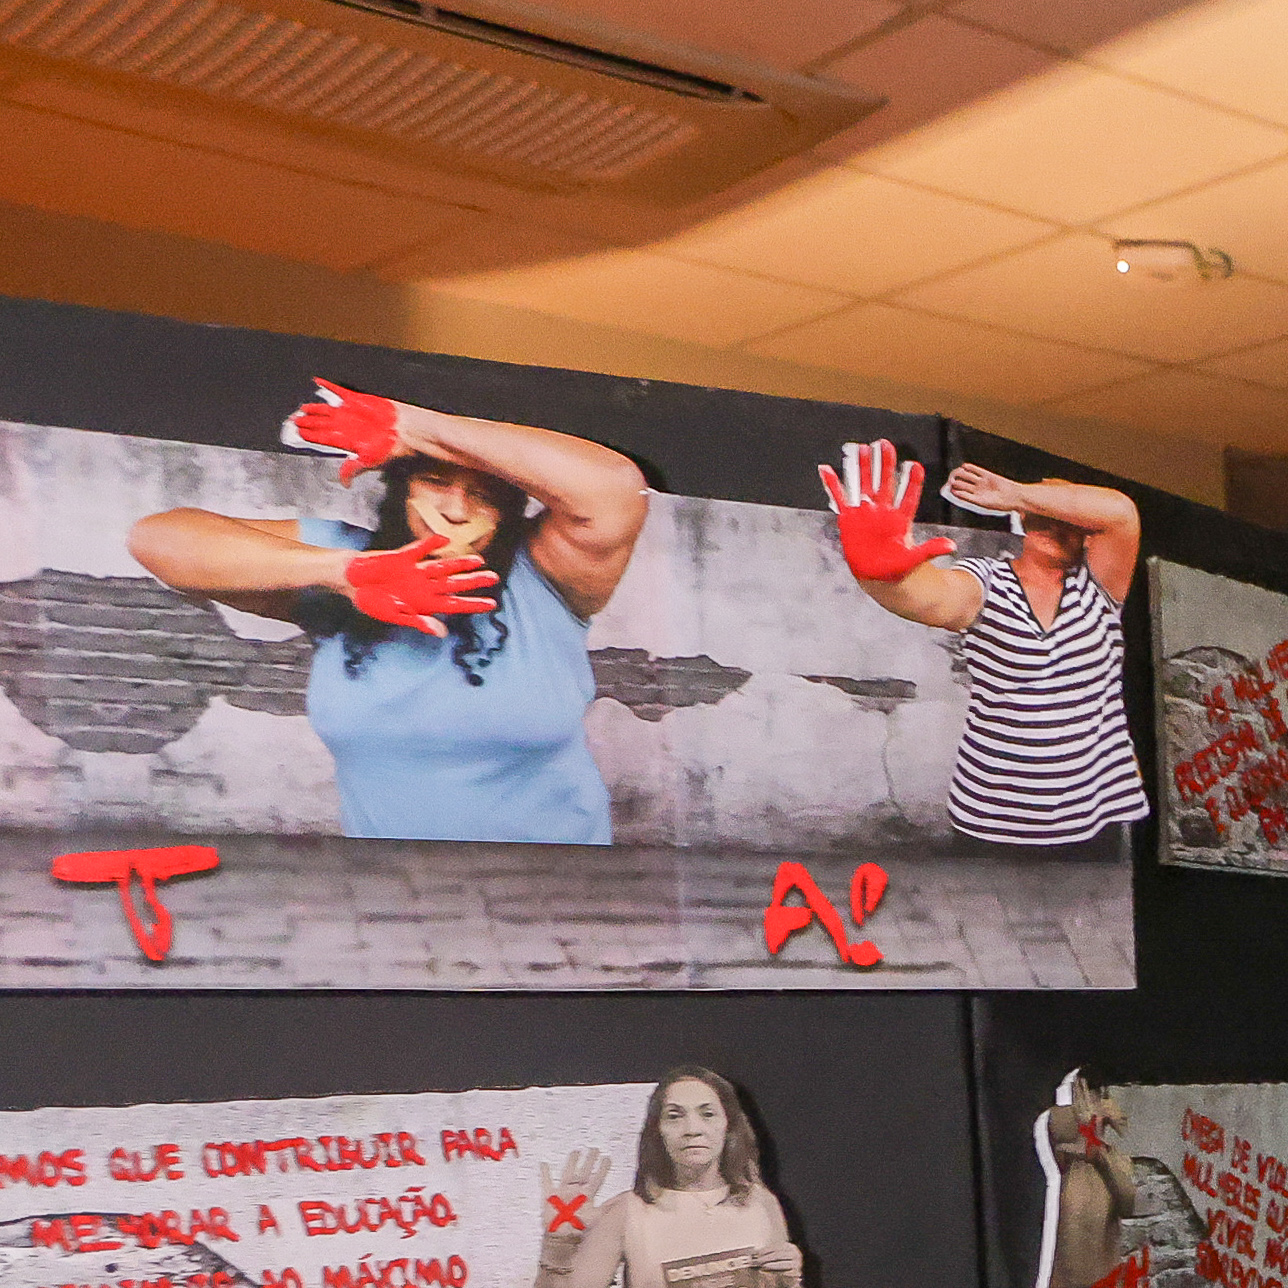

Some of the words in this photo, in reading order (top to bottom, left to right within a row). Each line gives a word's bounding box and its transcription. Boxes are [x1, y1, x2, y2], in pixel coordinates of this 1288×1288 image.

[0, 1148, 87, 1188] MOS
[109, 1143, 186, 1182] QUE
[203, 1130, 426, 1178] CONTRIBUIR
[441, 1127, 519, 1161] PARA
[258, 1204, 281, 1236] A
